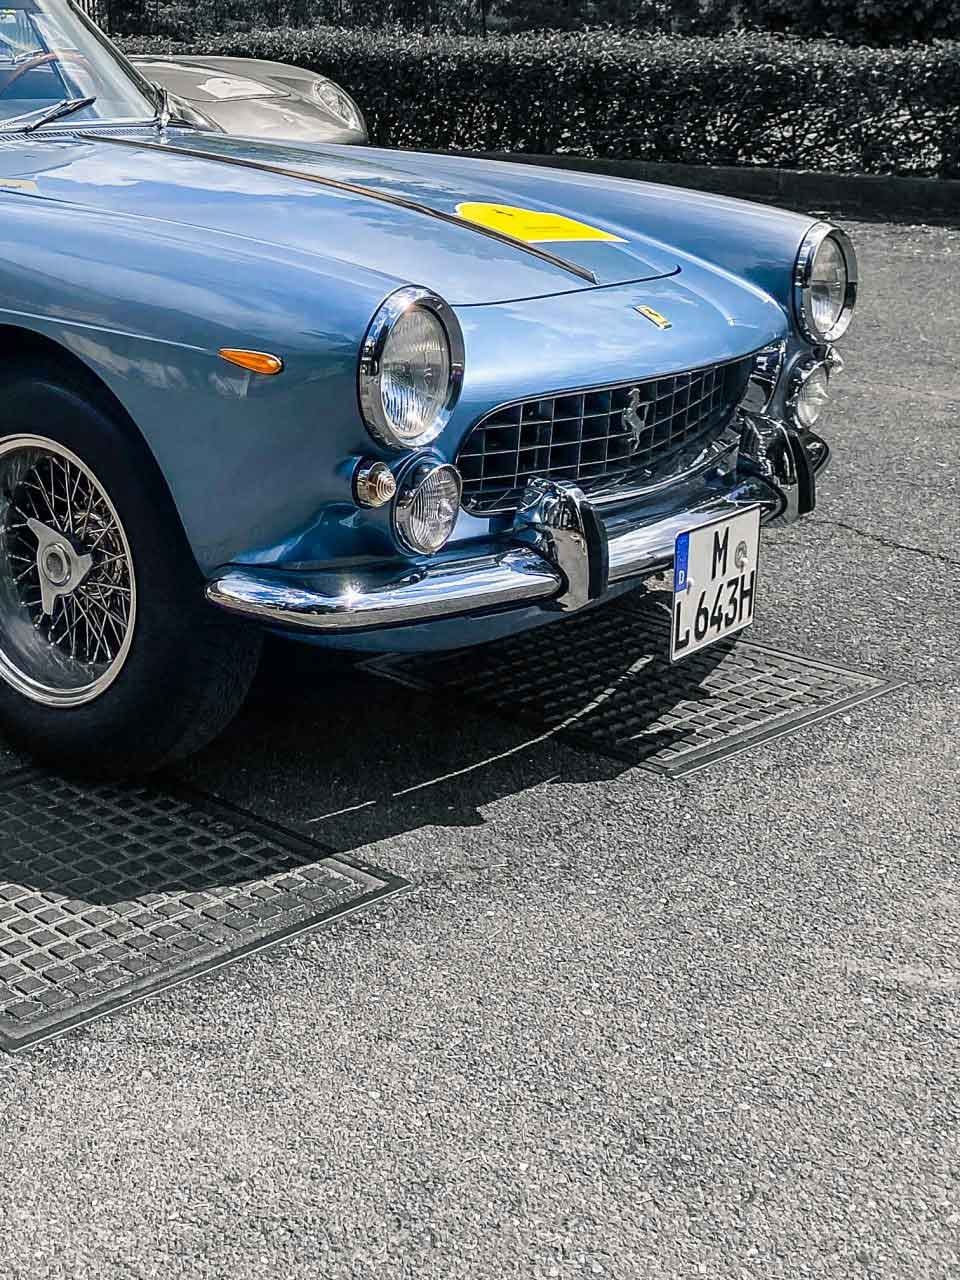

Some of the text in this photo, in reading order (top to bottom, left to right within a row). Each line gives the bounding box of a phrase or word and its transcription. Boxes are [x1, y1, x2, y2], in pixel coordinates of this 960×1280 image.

[711, 526, 730, 581] M
[674, 570, 755, 652] L 643H
